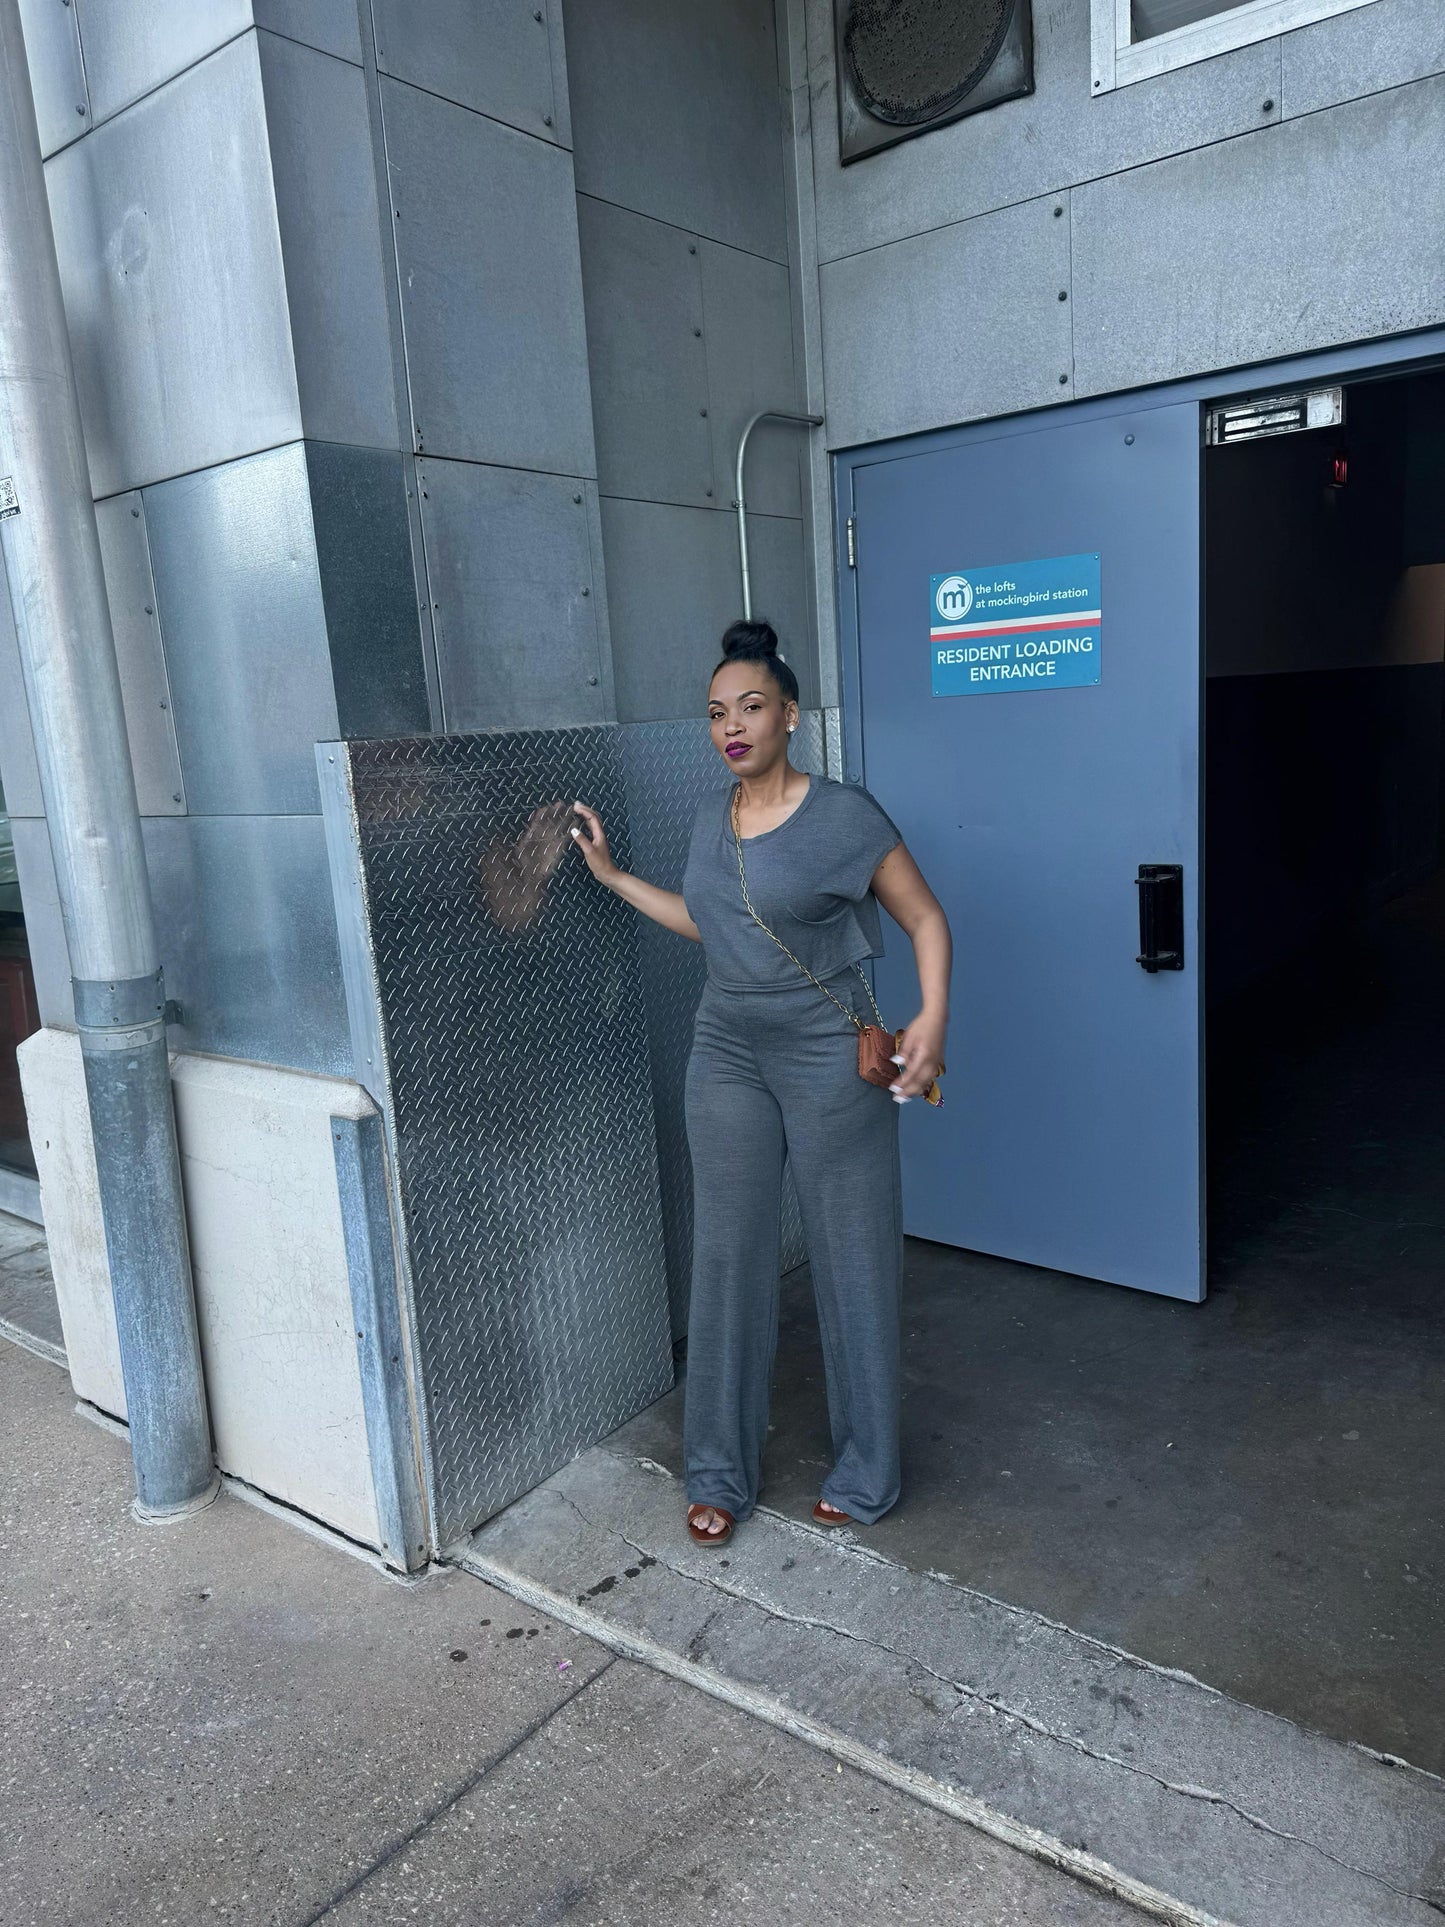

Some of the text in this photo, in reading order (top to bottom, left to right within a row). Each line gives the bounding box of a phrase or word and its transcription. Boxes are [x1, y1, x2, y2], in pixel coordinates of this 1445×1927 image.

[975, 580, 1016, 595] the lofts
[975, 587, 1089, 608] at mockingbird station
[937, 636, 1093, 665] RESIDENT LOADING
[970, 661, 1056, 681] ENTRANCE
